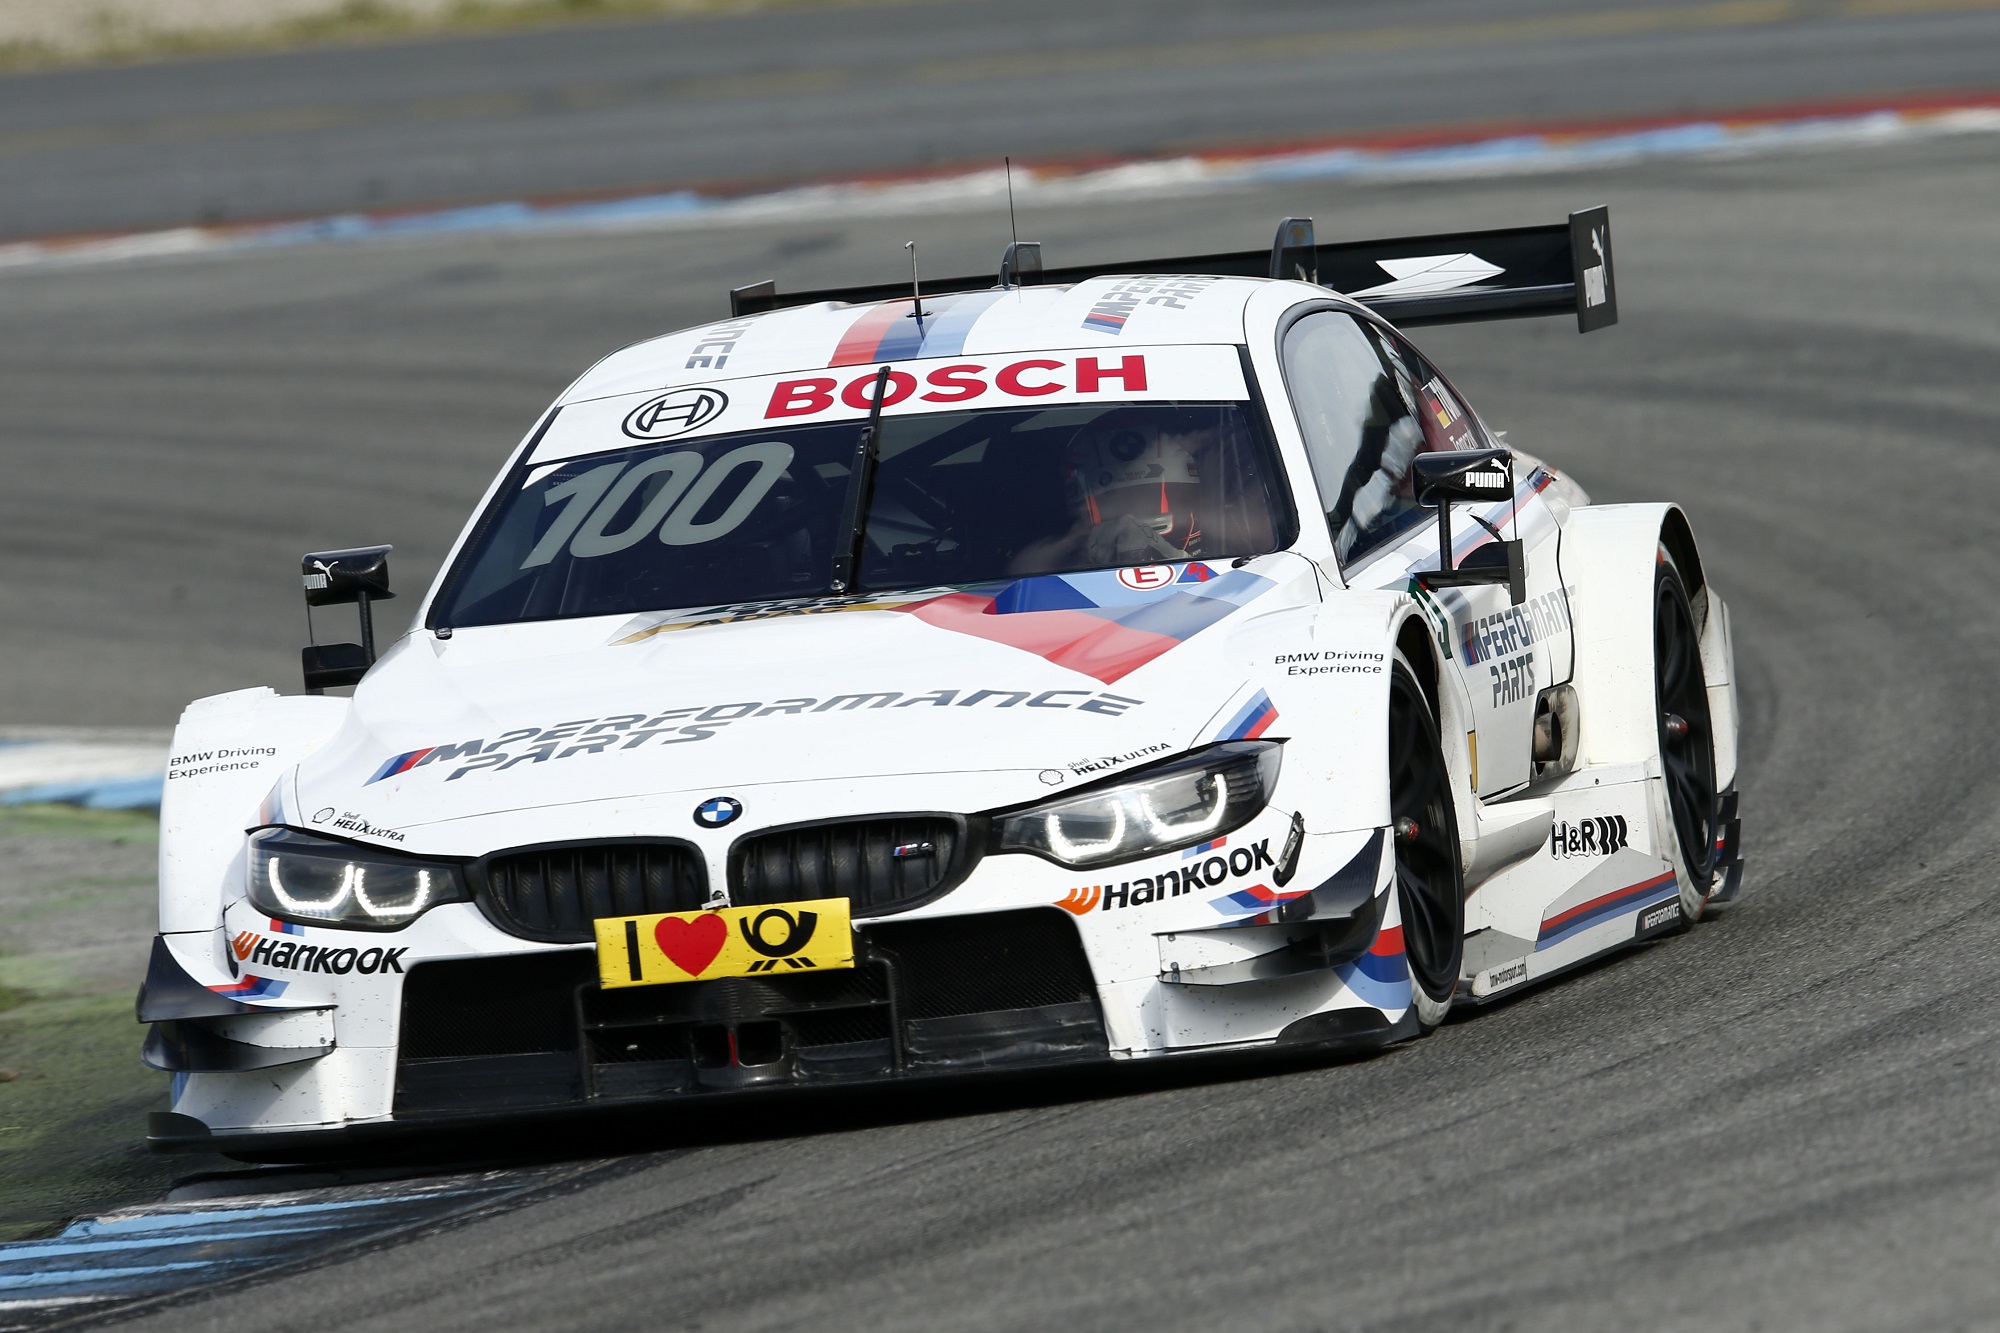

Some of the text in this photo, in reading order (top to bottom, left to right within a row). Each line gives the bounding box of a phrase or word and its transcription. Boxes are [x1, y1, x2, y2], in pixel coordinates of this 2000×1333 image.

[764, 355, 1147, 419] BOSCH
[1465, 471, 1505, 489] PUMA
[518, 441, 795, 570] 100
[1275, 650, 1384, 664] BMW Driving
[1288, 663, 1382, 676] Experience
[1490, 652, 1535, 708] PARTS
[170, 746, 276, 767] BMW Driving
[444, 721, 733, 782] PARTS
[1067, 757, 1090, 769] Shell
[1070, 742, 1172, 776] HELIX ULTRA
[168, 761, 260, 780] Experience
[341, 811, 361, 820] Shell
[333, 818, 405, 842] HELIX ULTRA
[1551, 820, 1598, 858] H&R
[625, 920, 642, 981] I
